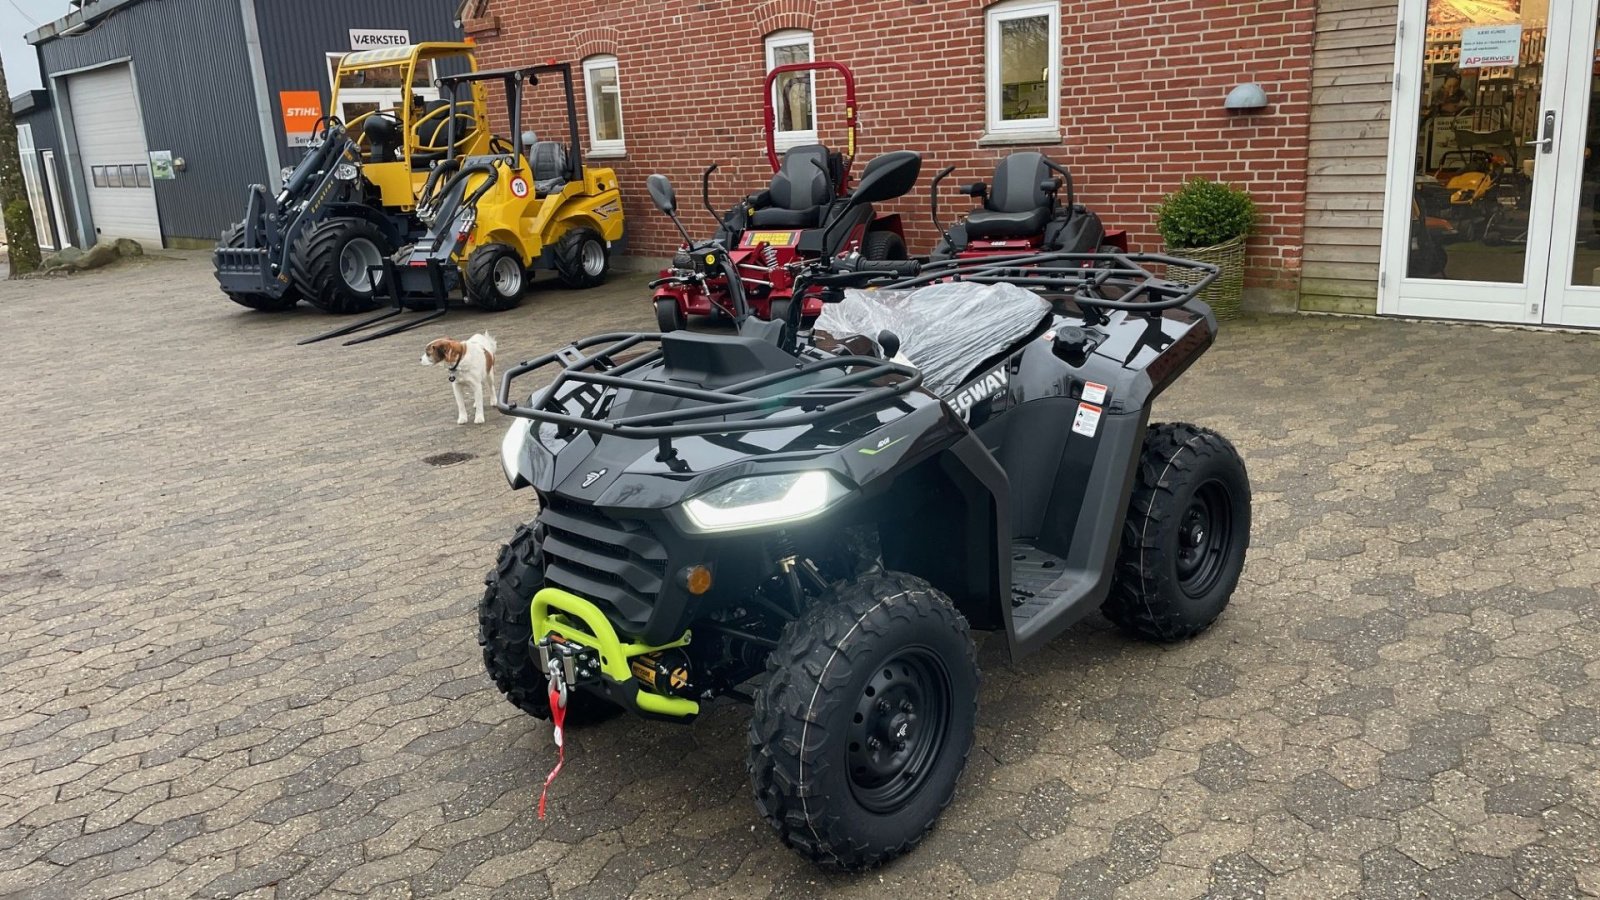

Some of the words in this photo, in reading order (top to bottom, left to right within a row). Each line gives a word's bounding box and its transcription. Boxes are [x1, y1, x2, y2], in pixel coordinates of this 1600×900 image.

[353, 34, 407, 45] VÆRKSTED
[286, 107, 319, 117] STIHL
[295, 136, 320, 144] Serve
[515, 182, 525, 193] 20
[947, 365, 1008, 424] EGWAY
